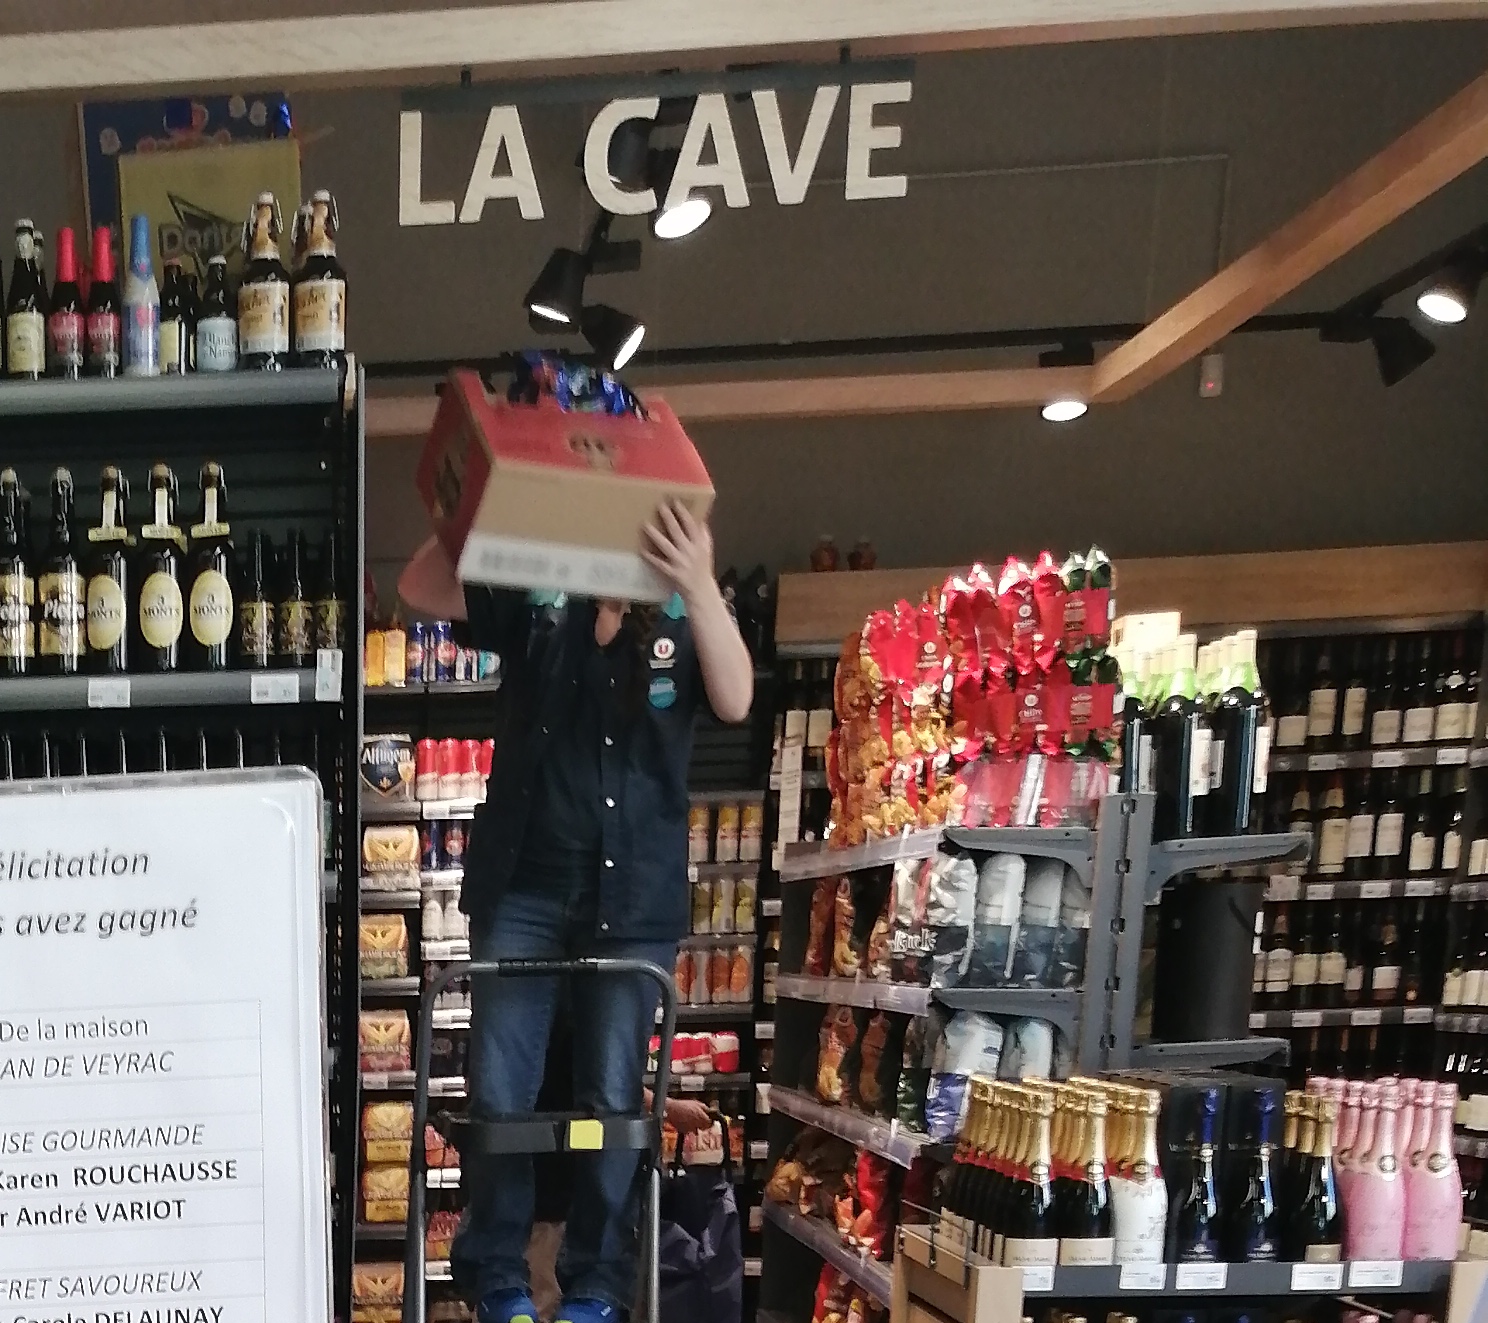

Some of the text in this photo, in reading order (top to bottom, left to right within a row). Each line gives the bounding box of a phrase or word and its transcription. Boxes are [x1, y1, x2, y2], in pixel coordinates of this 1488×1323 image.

[399, 82, 913, 226] LA CAVE
[15, 912, 87, 937] avez
[98, 896, 200, 938] gagné
[37, 1017, 57, 1042] la
[63, 1015, 149, 1039] maison
[42, 1054, 75, 1078] DE
[80, 1050, 175, 1077] VEYRAC
[42, 1123, 205, 1153] GOURMANDE
[73, 1159, 239, 1188] ROUCHAUSSE
[16, 1200, 88, 1227] André
[95, 1197, 187, 1224] VARIOT
[57, 1269, 204, 1299] SAVOUREUX
